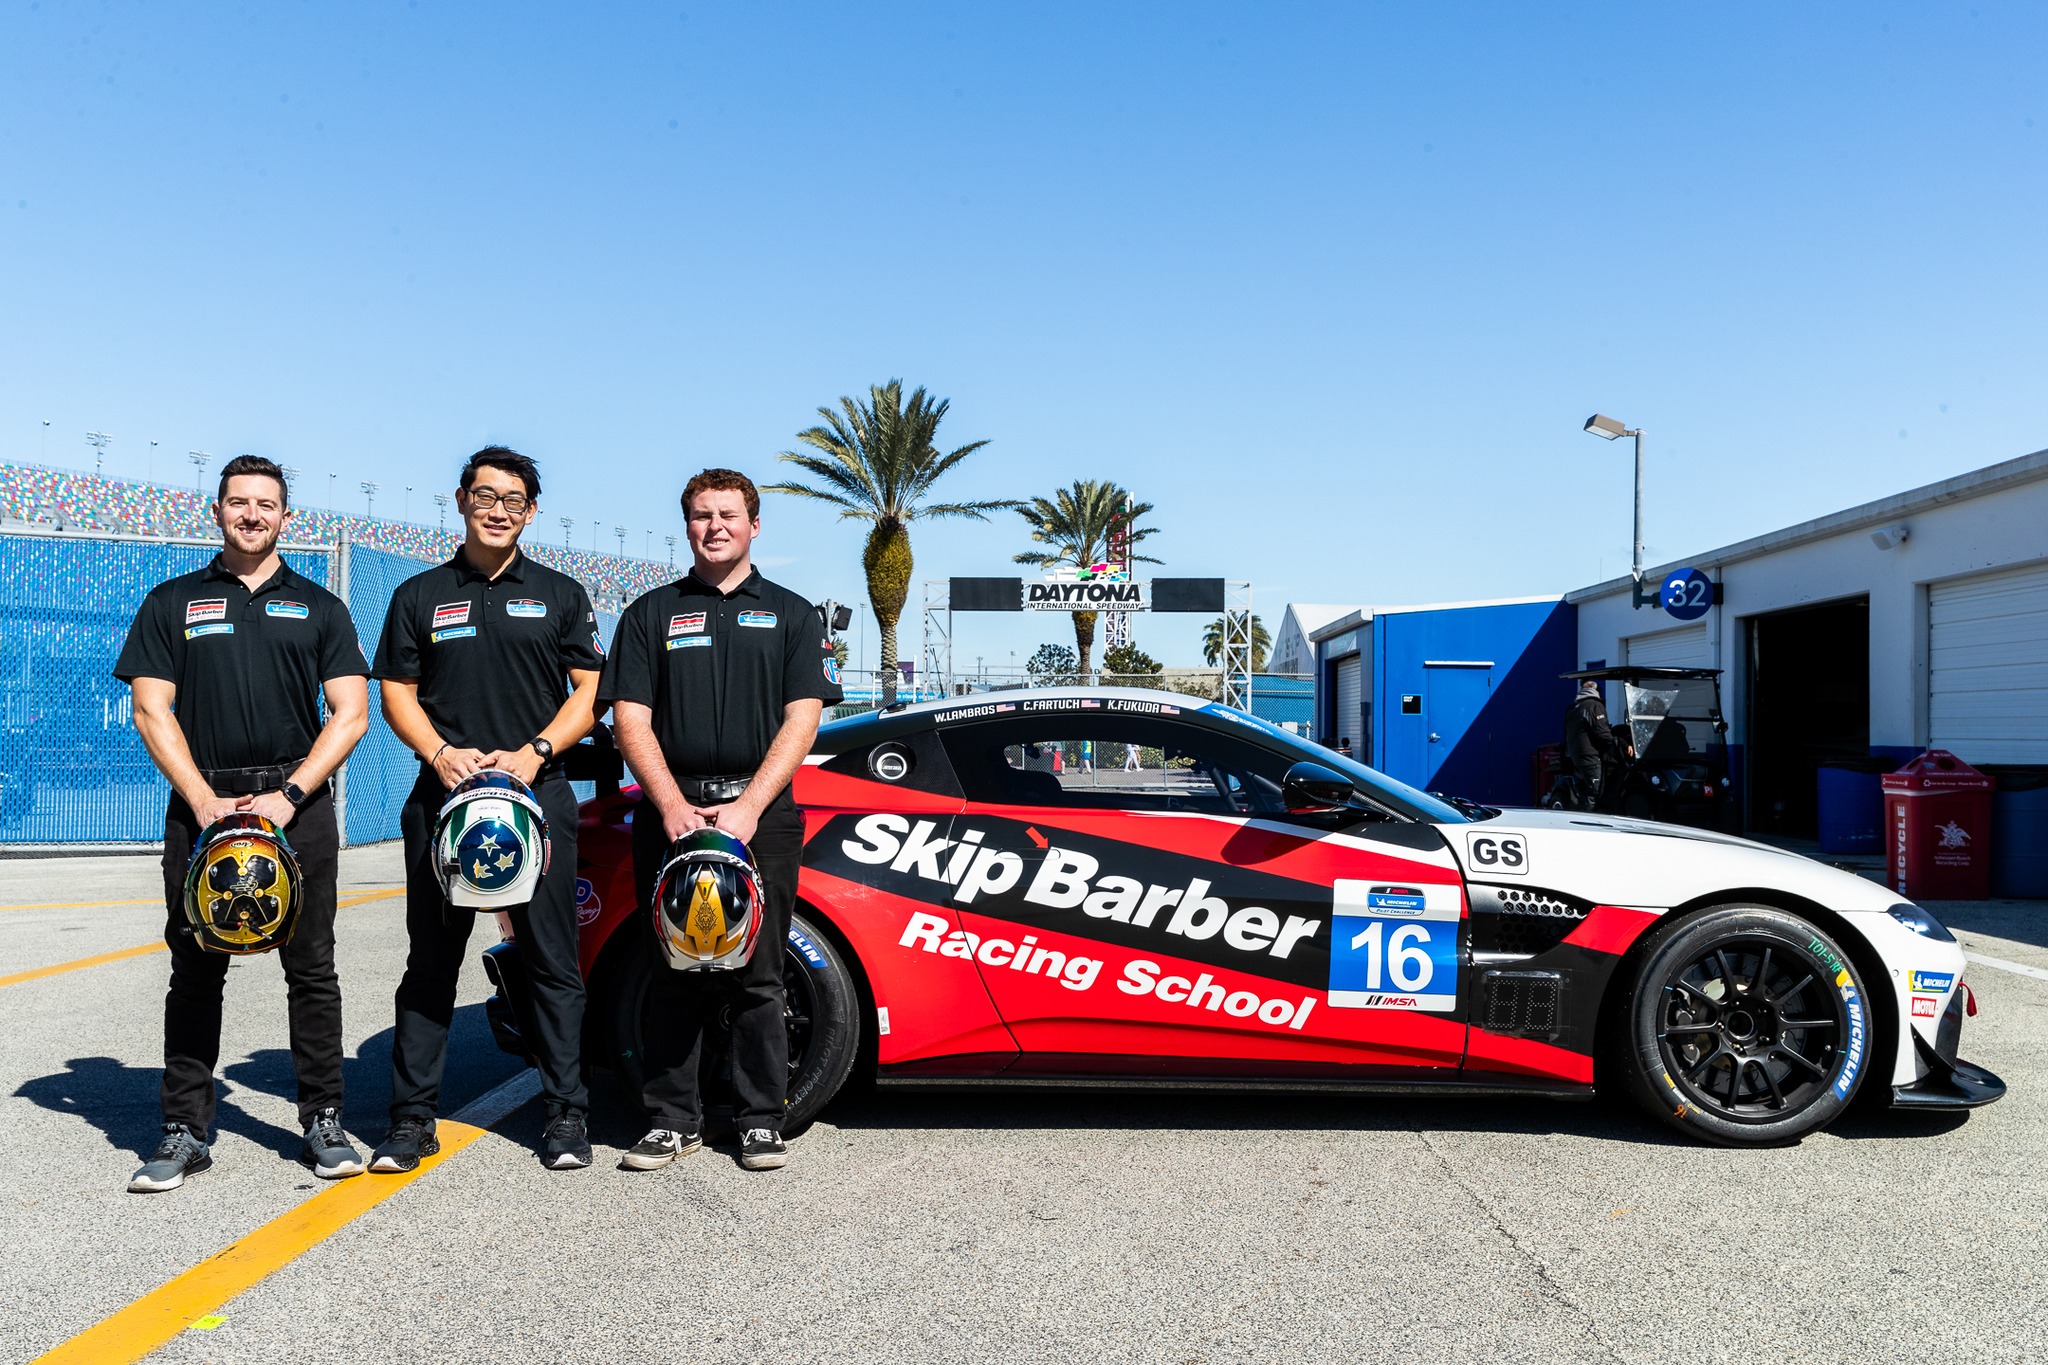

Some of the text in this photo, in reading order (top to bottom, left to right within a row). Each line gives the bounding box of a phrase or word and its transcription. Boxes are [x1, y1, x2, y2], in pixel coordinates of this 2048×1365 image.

[1027, 602, 1140, 610] INTERNATIONAL SPEEDWAY
[1028, 584, 1141, 602] DAYTONA
[1668, 579, 1706, 607] 32
[934, 704, 996, 723] W.LAMBROS
[1023, 699, 1080, 711] C.FARTUCH
[1107, 699, 1160, 713] K.FUKUDA
[1473, 838, 1524, 867] GS
[1897, 805, 1906, 894] RECYCLE
[841, 813, 1321, 959] Skip Barber
[788, 930, 821, 962] ELIN
[1351, 922, 1434, 992] 16
[898, 911, 1318, 1030] Racing School
[1382, 997, 1418, 1007] IMSA
[1912, 999, 1936, 1015] MOTUL
[1838, 1003, 1863, 1092] MICHELIN
